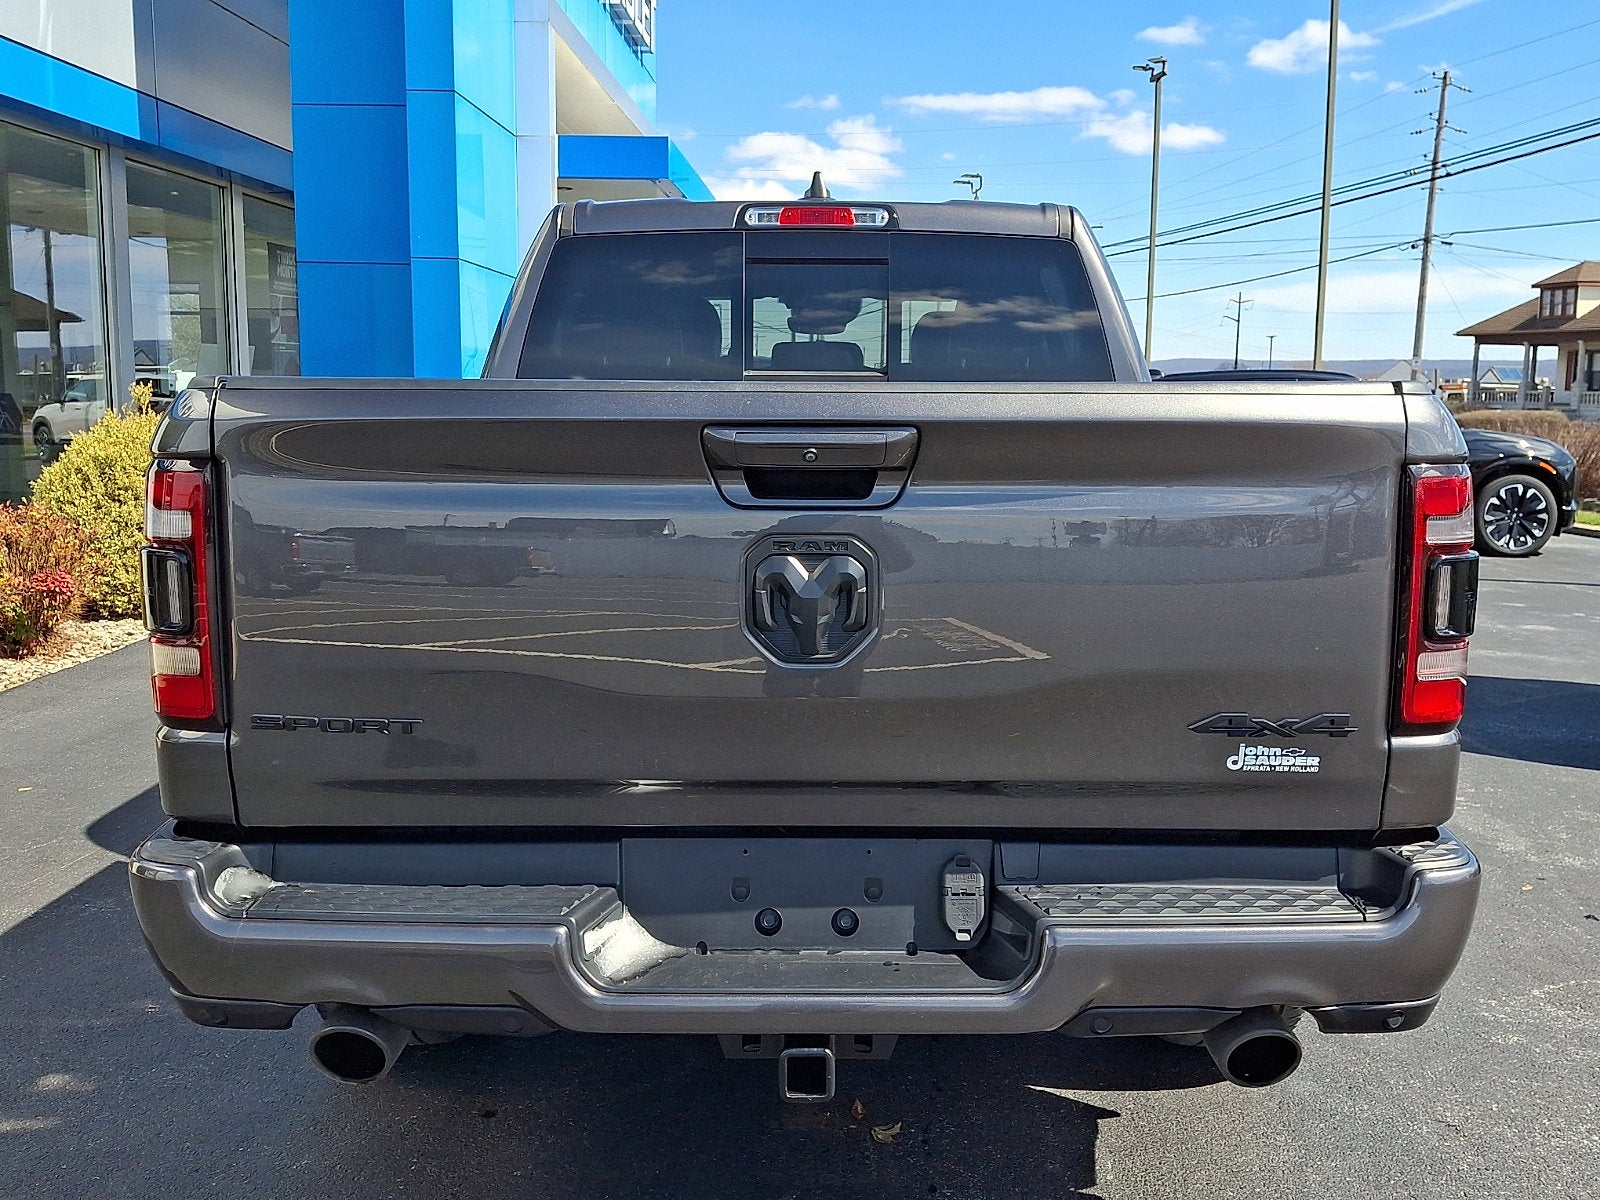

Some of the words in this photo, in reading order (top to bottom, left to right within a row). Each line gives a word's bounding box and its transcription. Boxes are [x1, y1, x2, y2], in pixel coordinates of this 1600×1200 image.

[276, 264, 297, 279] MONT
[772, 541, 849, 552] RAM
[251, 713, 423, 735] SPORT
[1244, 755, 1321, 767] SAUDER
